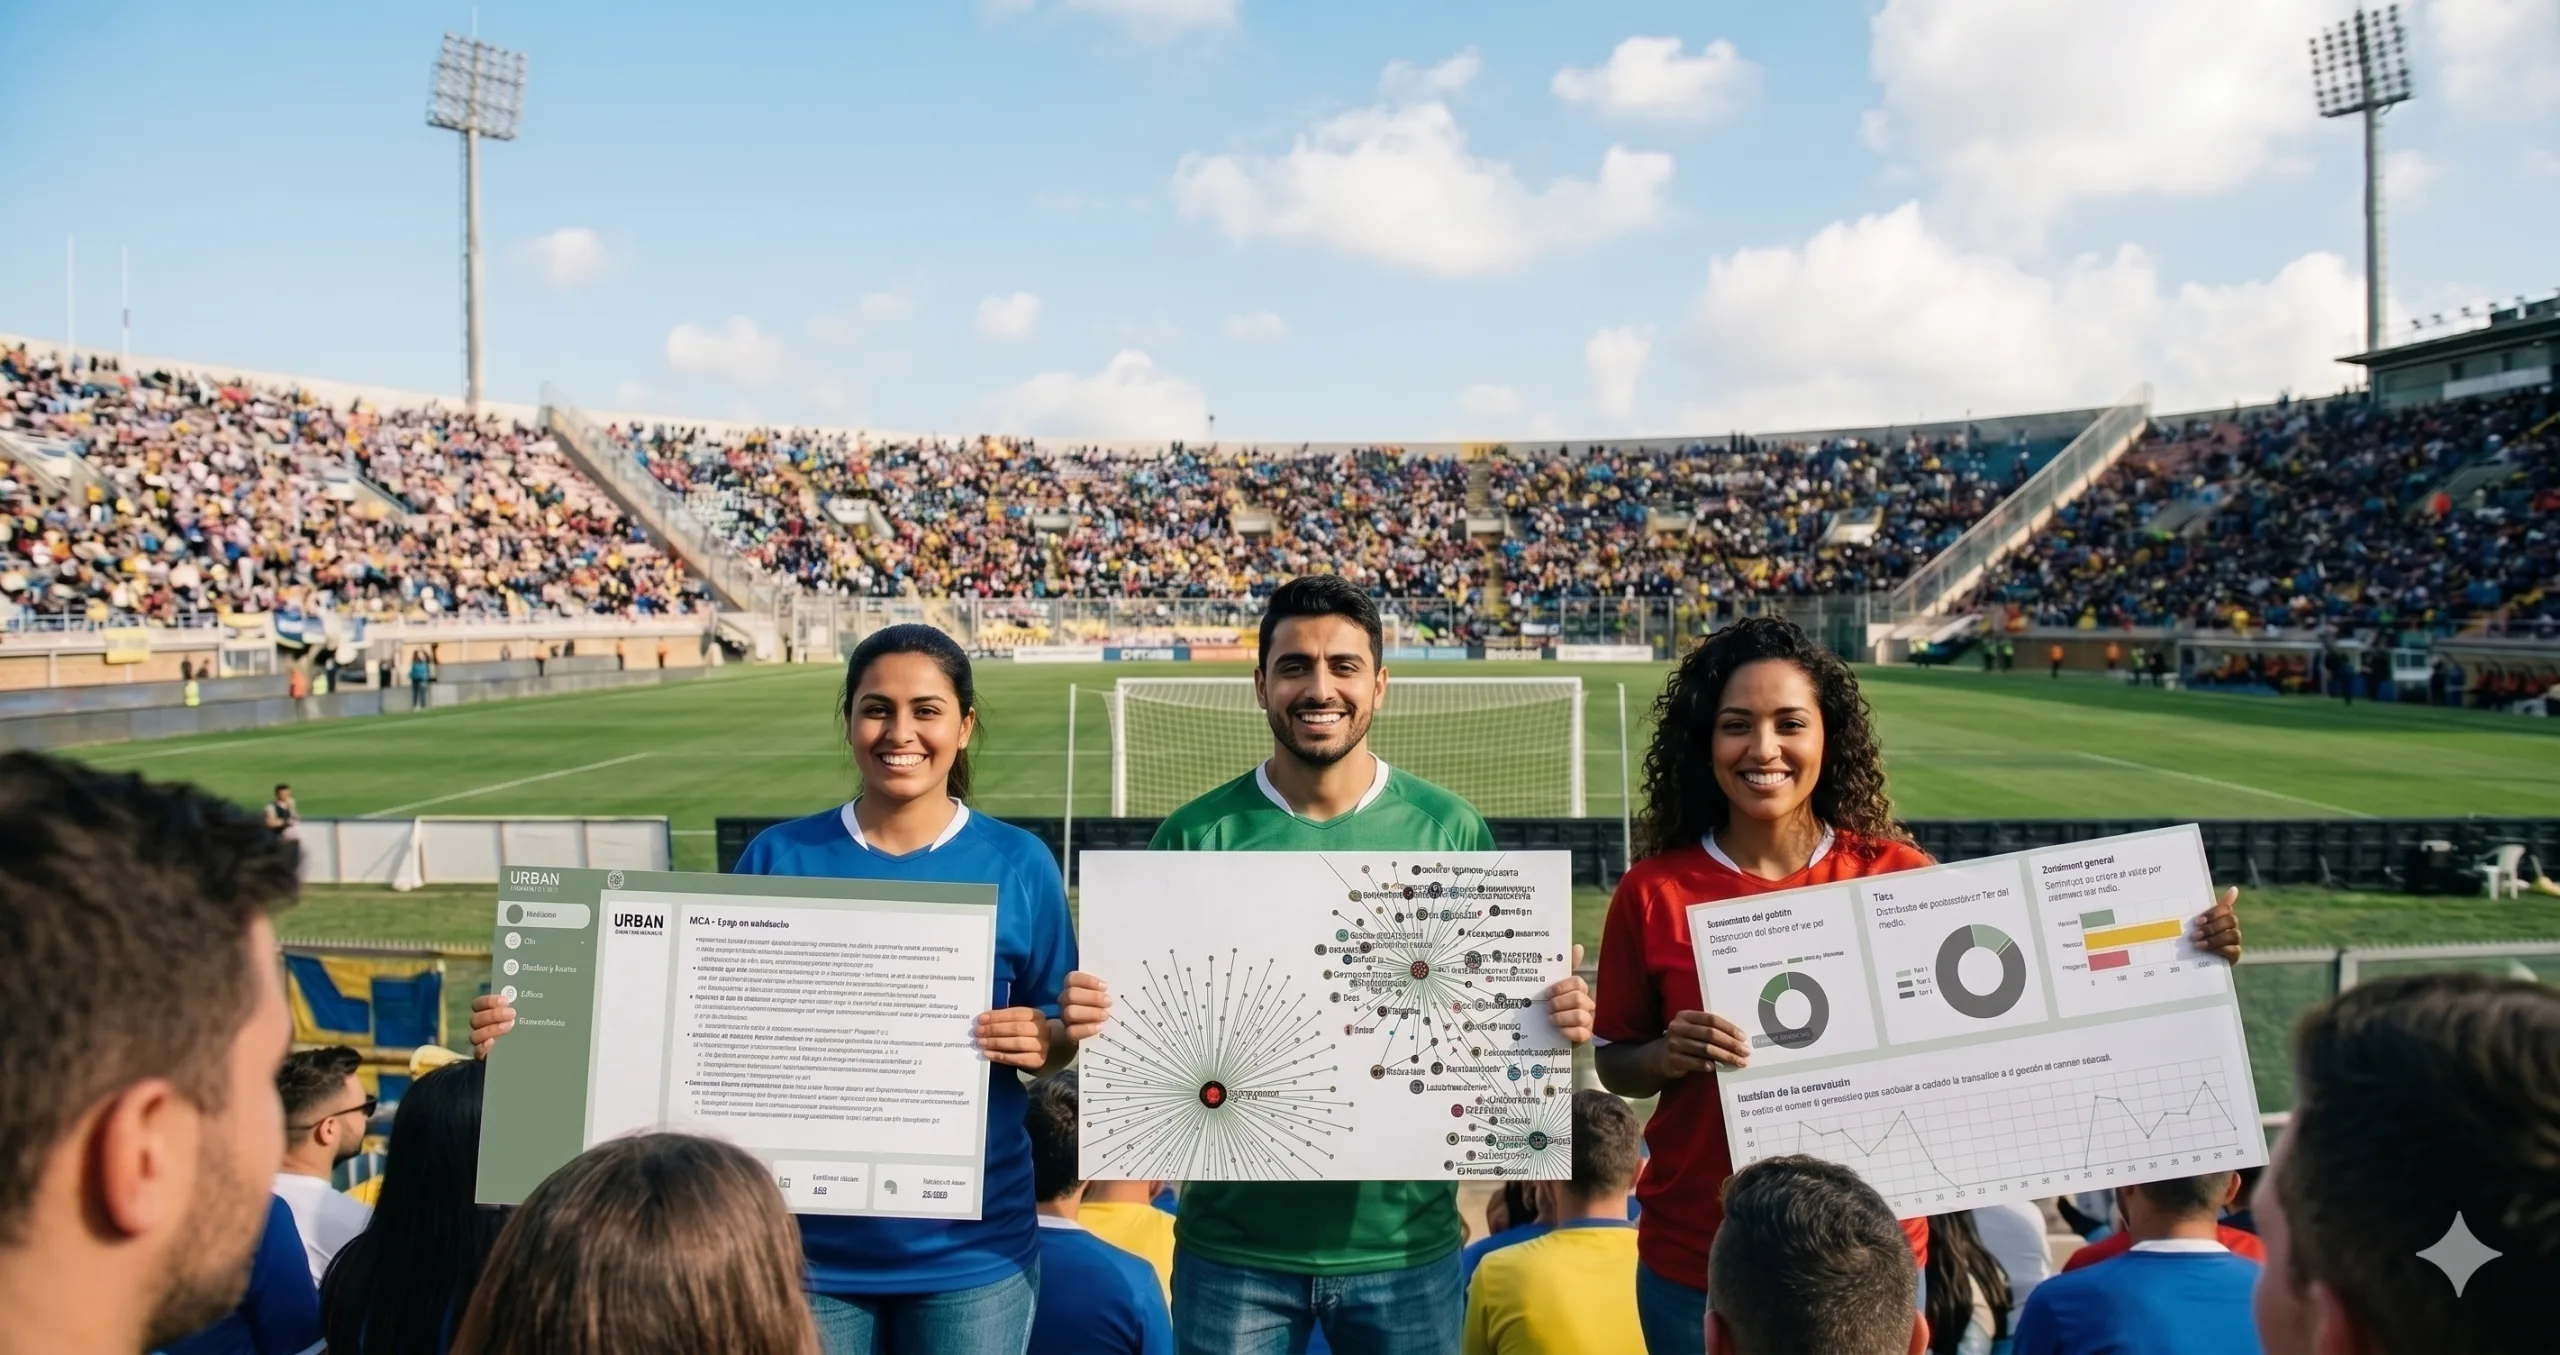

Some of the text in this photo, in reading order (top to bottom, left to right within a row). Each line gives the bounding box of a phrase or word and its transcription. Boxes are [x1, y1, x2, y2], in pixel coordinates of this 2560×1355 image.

[2084, 855, 2115, 869] general
[2149, 865, 2162, 876] por
[510, 871, 560, 886] URBAN
[614, 913, 664, 928] URBAN
[690, 917, 710, 925] MCA
[1752, 912, 1764, 922] del
[1914, 1084, 1920, 1092] a
[2001, 1070, 2007, 1078] a
[1777, 1087, 1789, 1098] de
[1790, 1085, 1800, 1096] la
